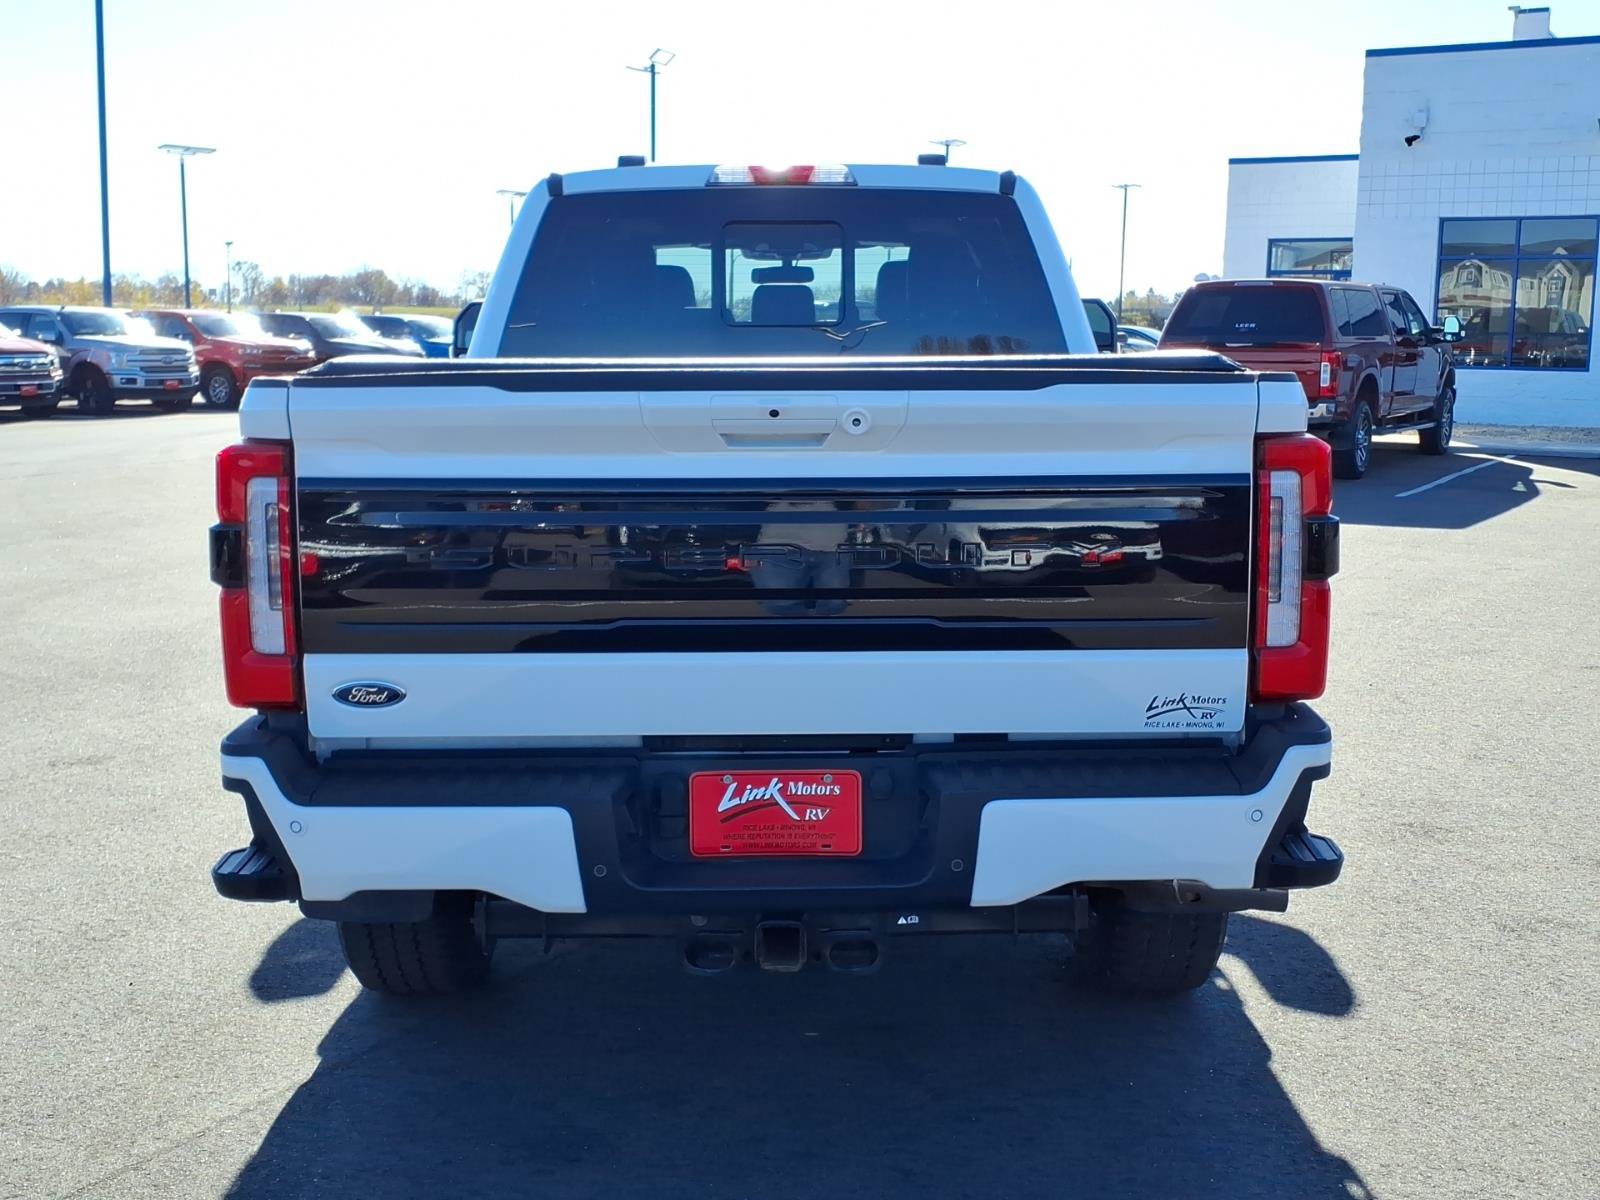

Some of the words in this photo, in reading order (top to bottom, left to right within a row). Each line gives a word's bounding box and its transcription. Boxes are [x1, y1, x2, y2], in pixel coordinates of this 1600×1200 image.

[348, 686, 389, 704] Ford
[1146, 692, 1197, 719] Link
[1189, 695, 1227, 705] Motors
[1201, 711, 1217, 720] RV
[1144, 721, 1160, 729] RICE
[1162, 721, 1180, 729] LAKE
[1216, 721, 1225, 729] WI
[717, 777, 801, 821] Link
[787, 781, 841, 796] Motors
[805, 808, 830, 821] RV
